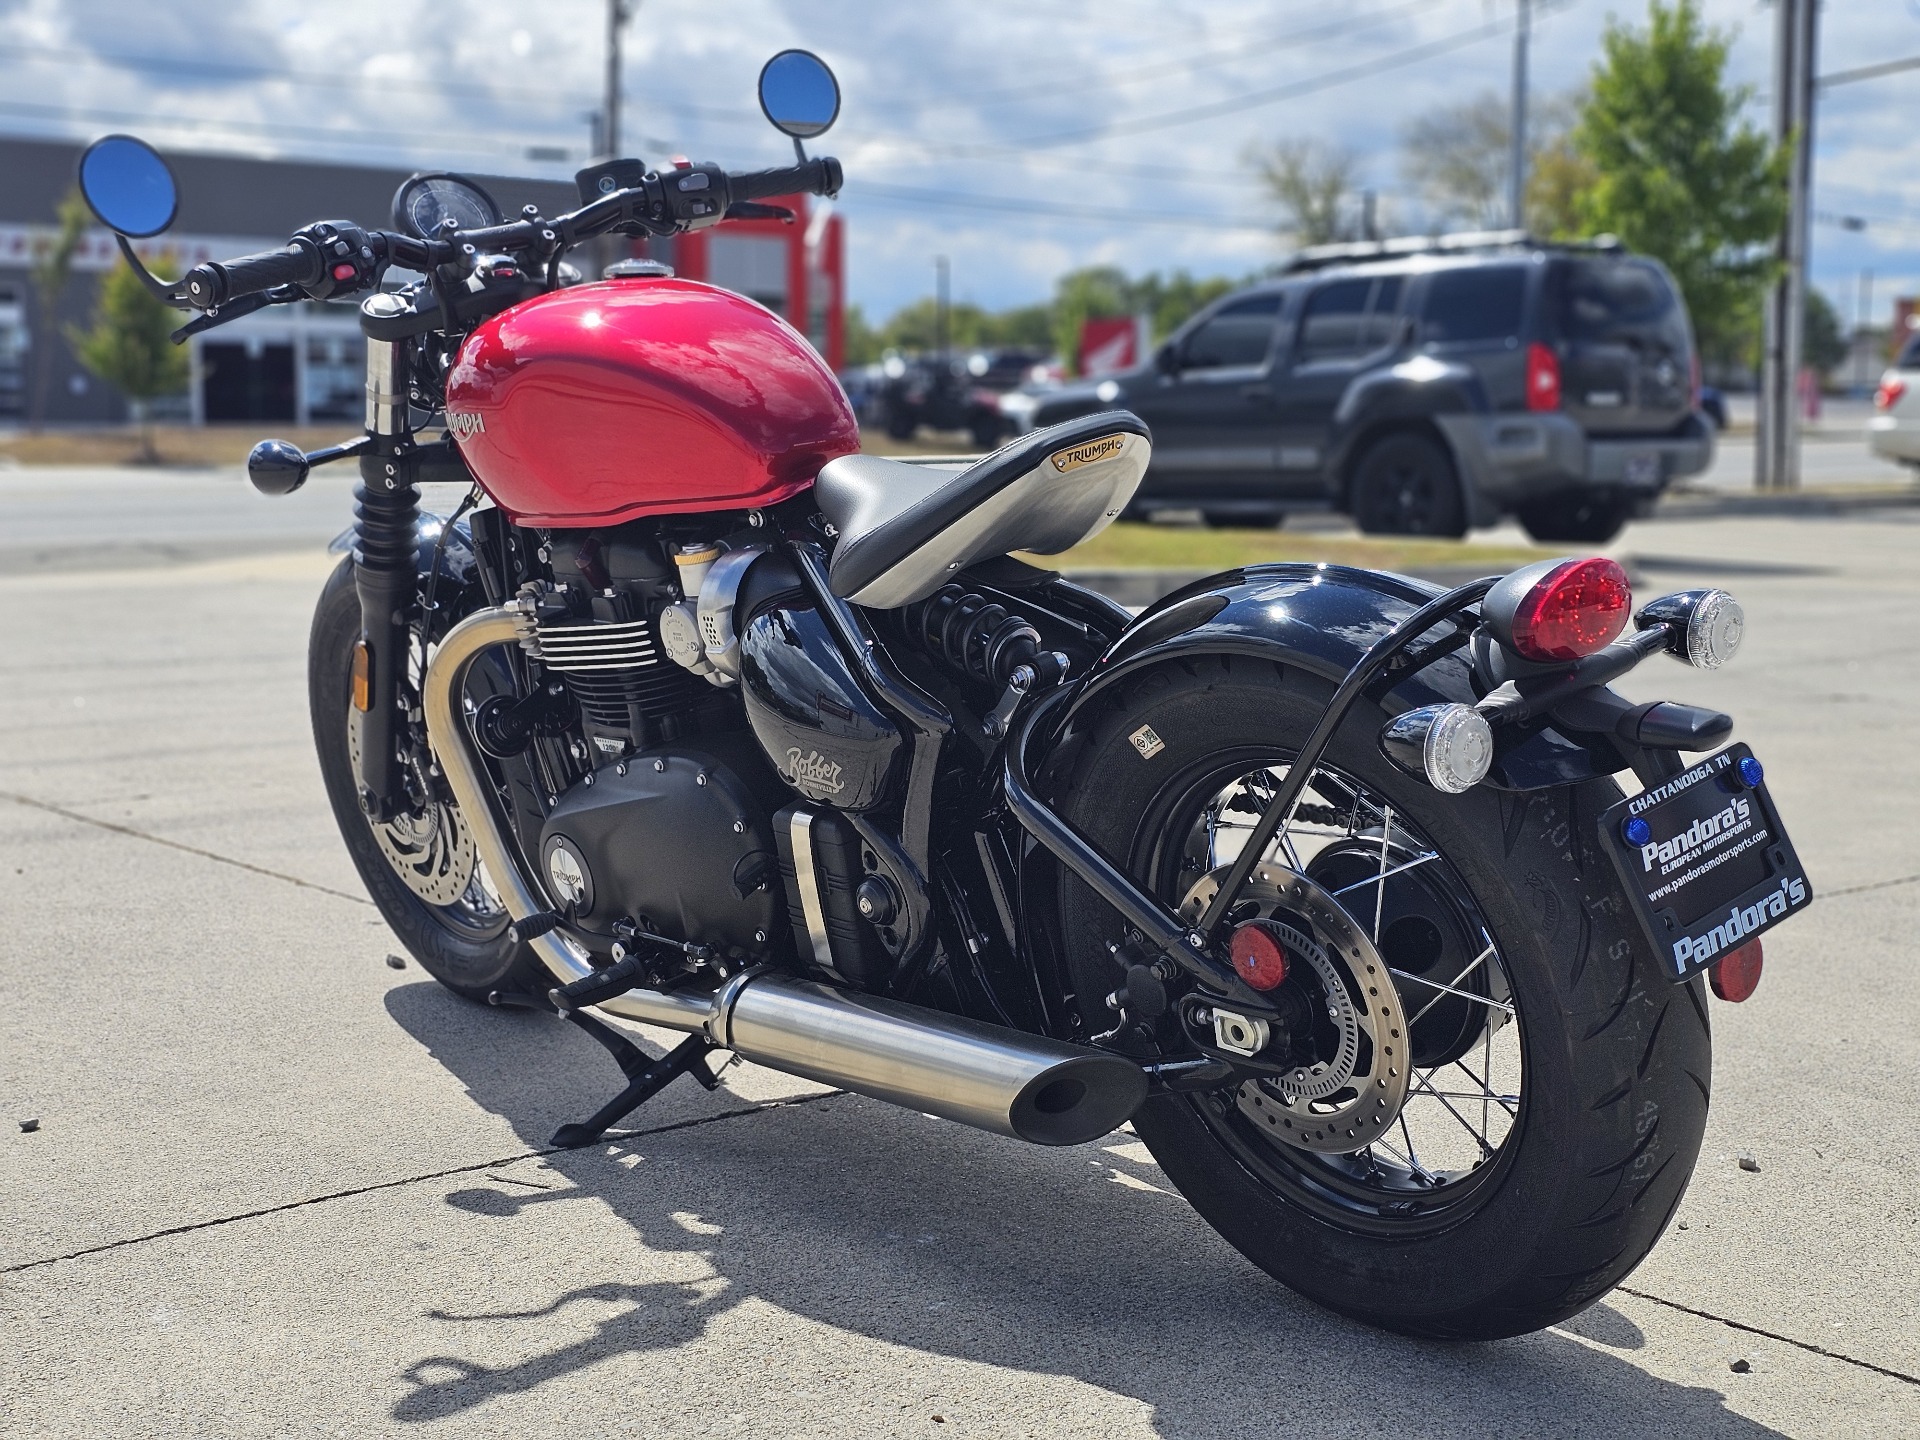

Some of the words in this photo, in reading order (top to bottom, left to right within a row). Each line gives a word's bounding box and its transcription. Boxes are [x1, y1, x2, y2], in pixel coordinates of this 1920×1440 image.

[1067, 440, 1115, 463] TRIUMPH
[786, 747, 845, 793] Bobber
[1628, 762, 1714, 815] CHATTANOOGA
[1715, 753, 1732, 769] TN
[1641, 798, 1750, 872] Pandora's
[1660, 845, 1702, 876] EUROPEAN
[1702, 819, 1752, 855] MOTORSPORTS
[552, 869, 582, 885] TRIUMPH
[1648, 829, 1768, 902] www.pandorasmotorsports.com
[1673, 877, 1806, 975] Pandora's
